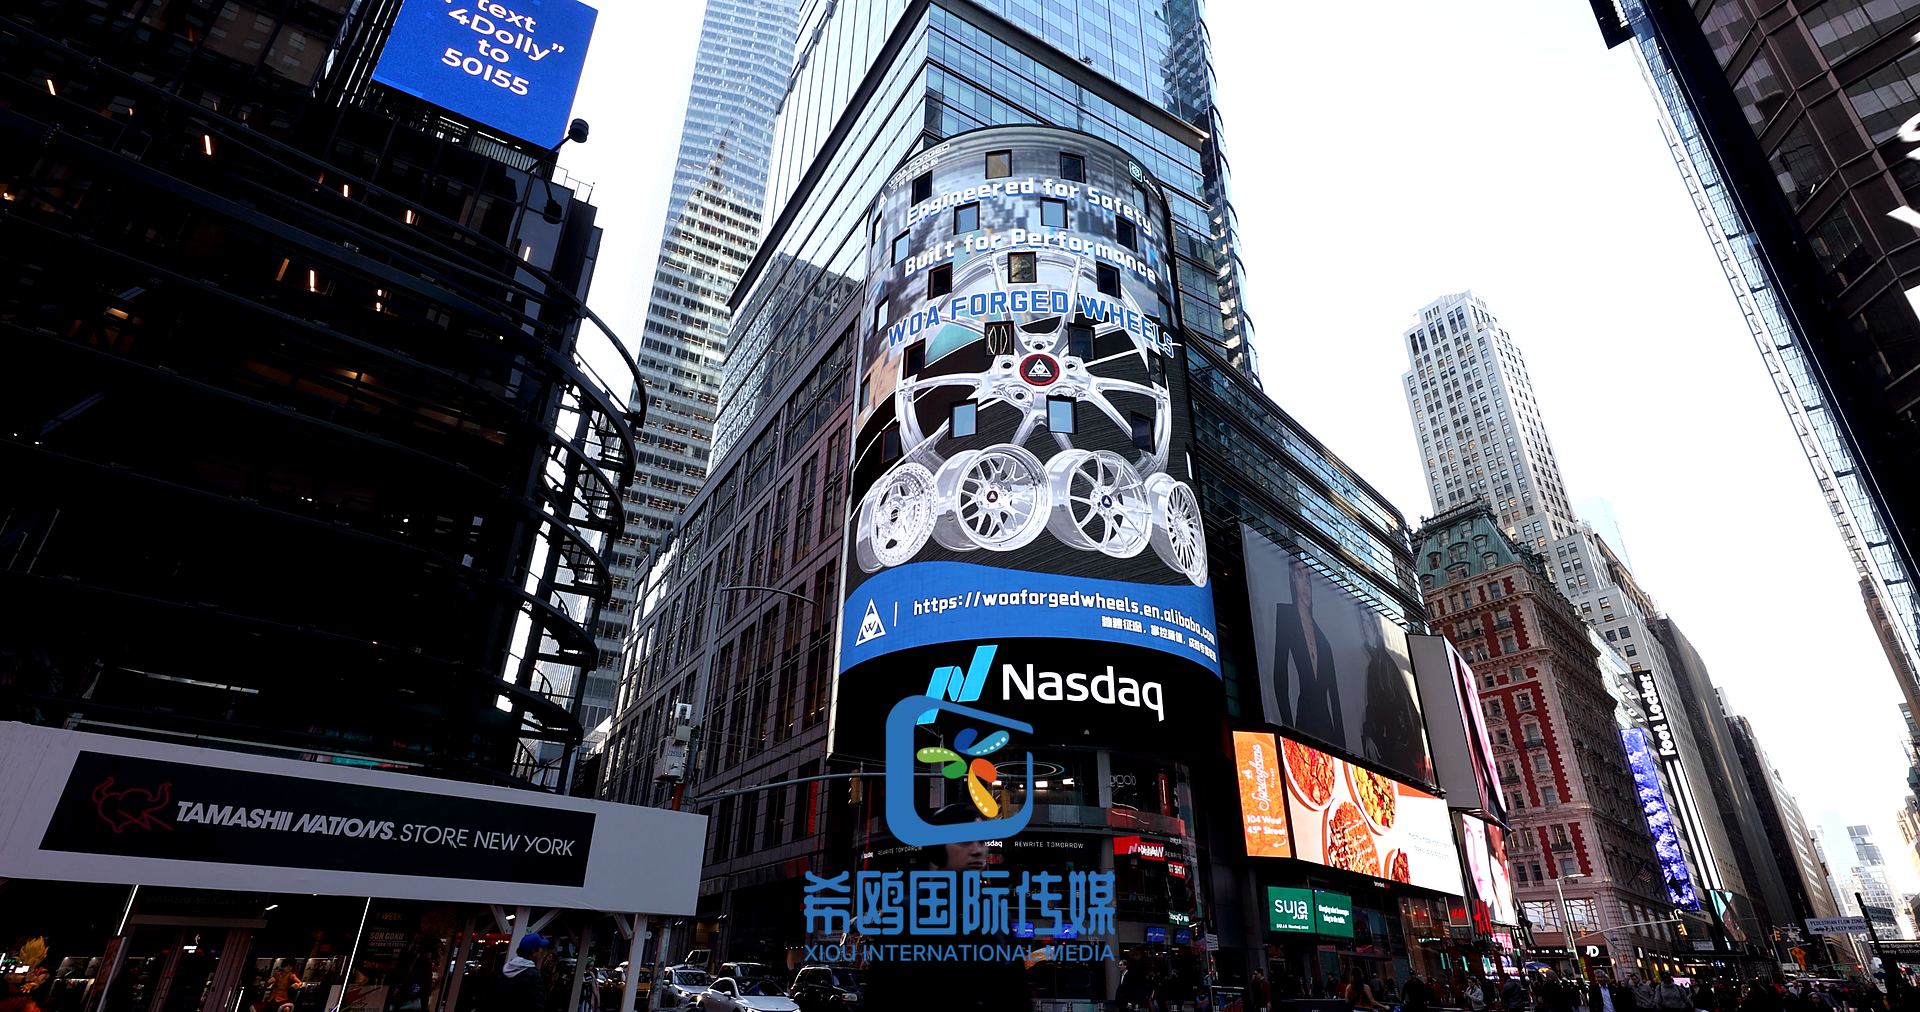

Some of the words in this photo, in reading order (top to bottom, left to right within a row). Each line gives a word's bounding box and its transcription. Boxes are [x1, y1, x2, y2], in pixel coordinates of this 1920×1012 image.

[478, 0, 537, 33] text
[441, 47, 530, 96] 50155
[478, 38, 510, 63] to
[907, 178, 1035, 226] Engineered
[1043, 178, 1079, 199] for
[1087, 185, 1153, 236] Safety
[905, 243, 955, 278] Built
[964, 233, 1001, 254] for
[1011, 228, 1156, 285] Performance
[887, 305, 940, 349] WOA
[950, 290, 1071, 321] FORGED
[1080, 293, 1175, 359] WHEELS
[1003, 664, 1165, 721] Nasdaq
[1639, 673, 1665, 722] Locker
[1659, 722, 1677, 756] Foot
[176, 800, 294, 832] TAMASHII
[292, 813, 395, 841] NATIONS
[400, 823, 469, 849] STORE
[473, 830, 521, 851] NEW
[524, 834, 575, 856] YORK
[1046, 841, 1084, 849] TOMORROW
[1274, 899, 1308, 920] suja
